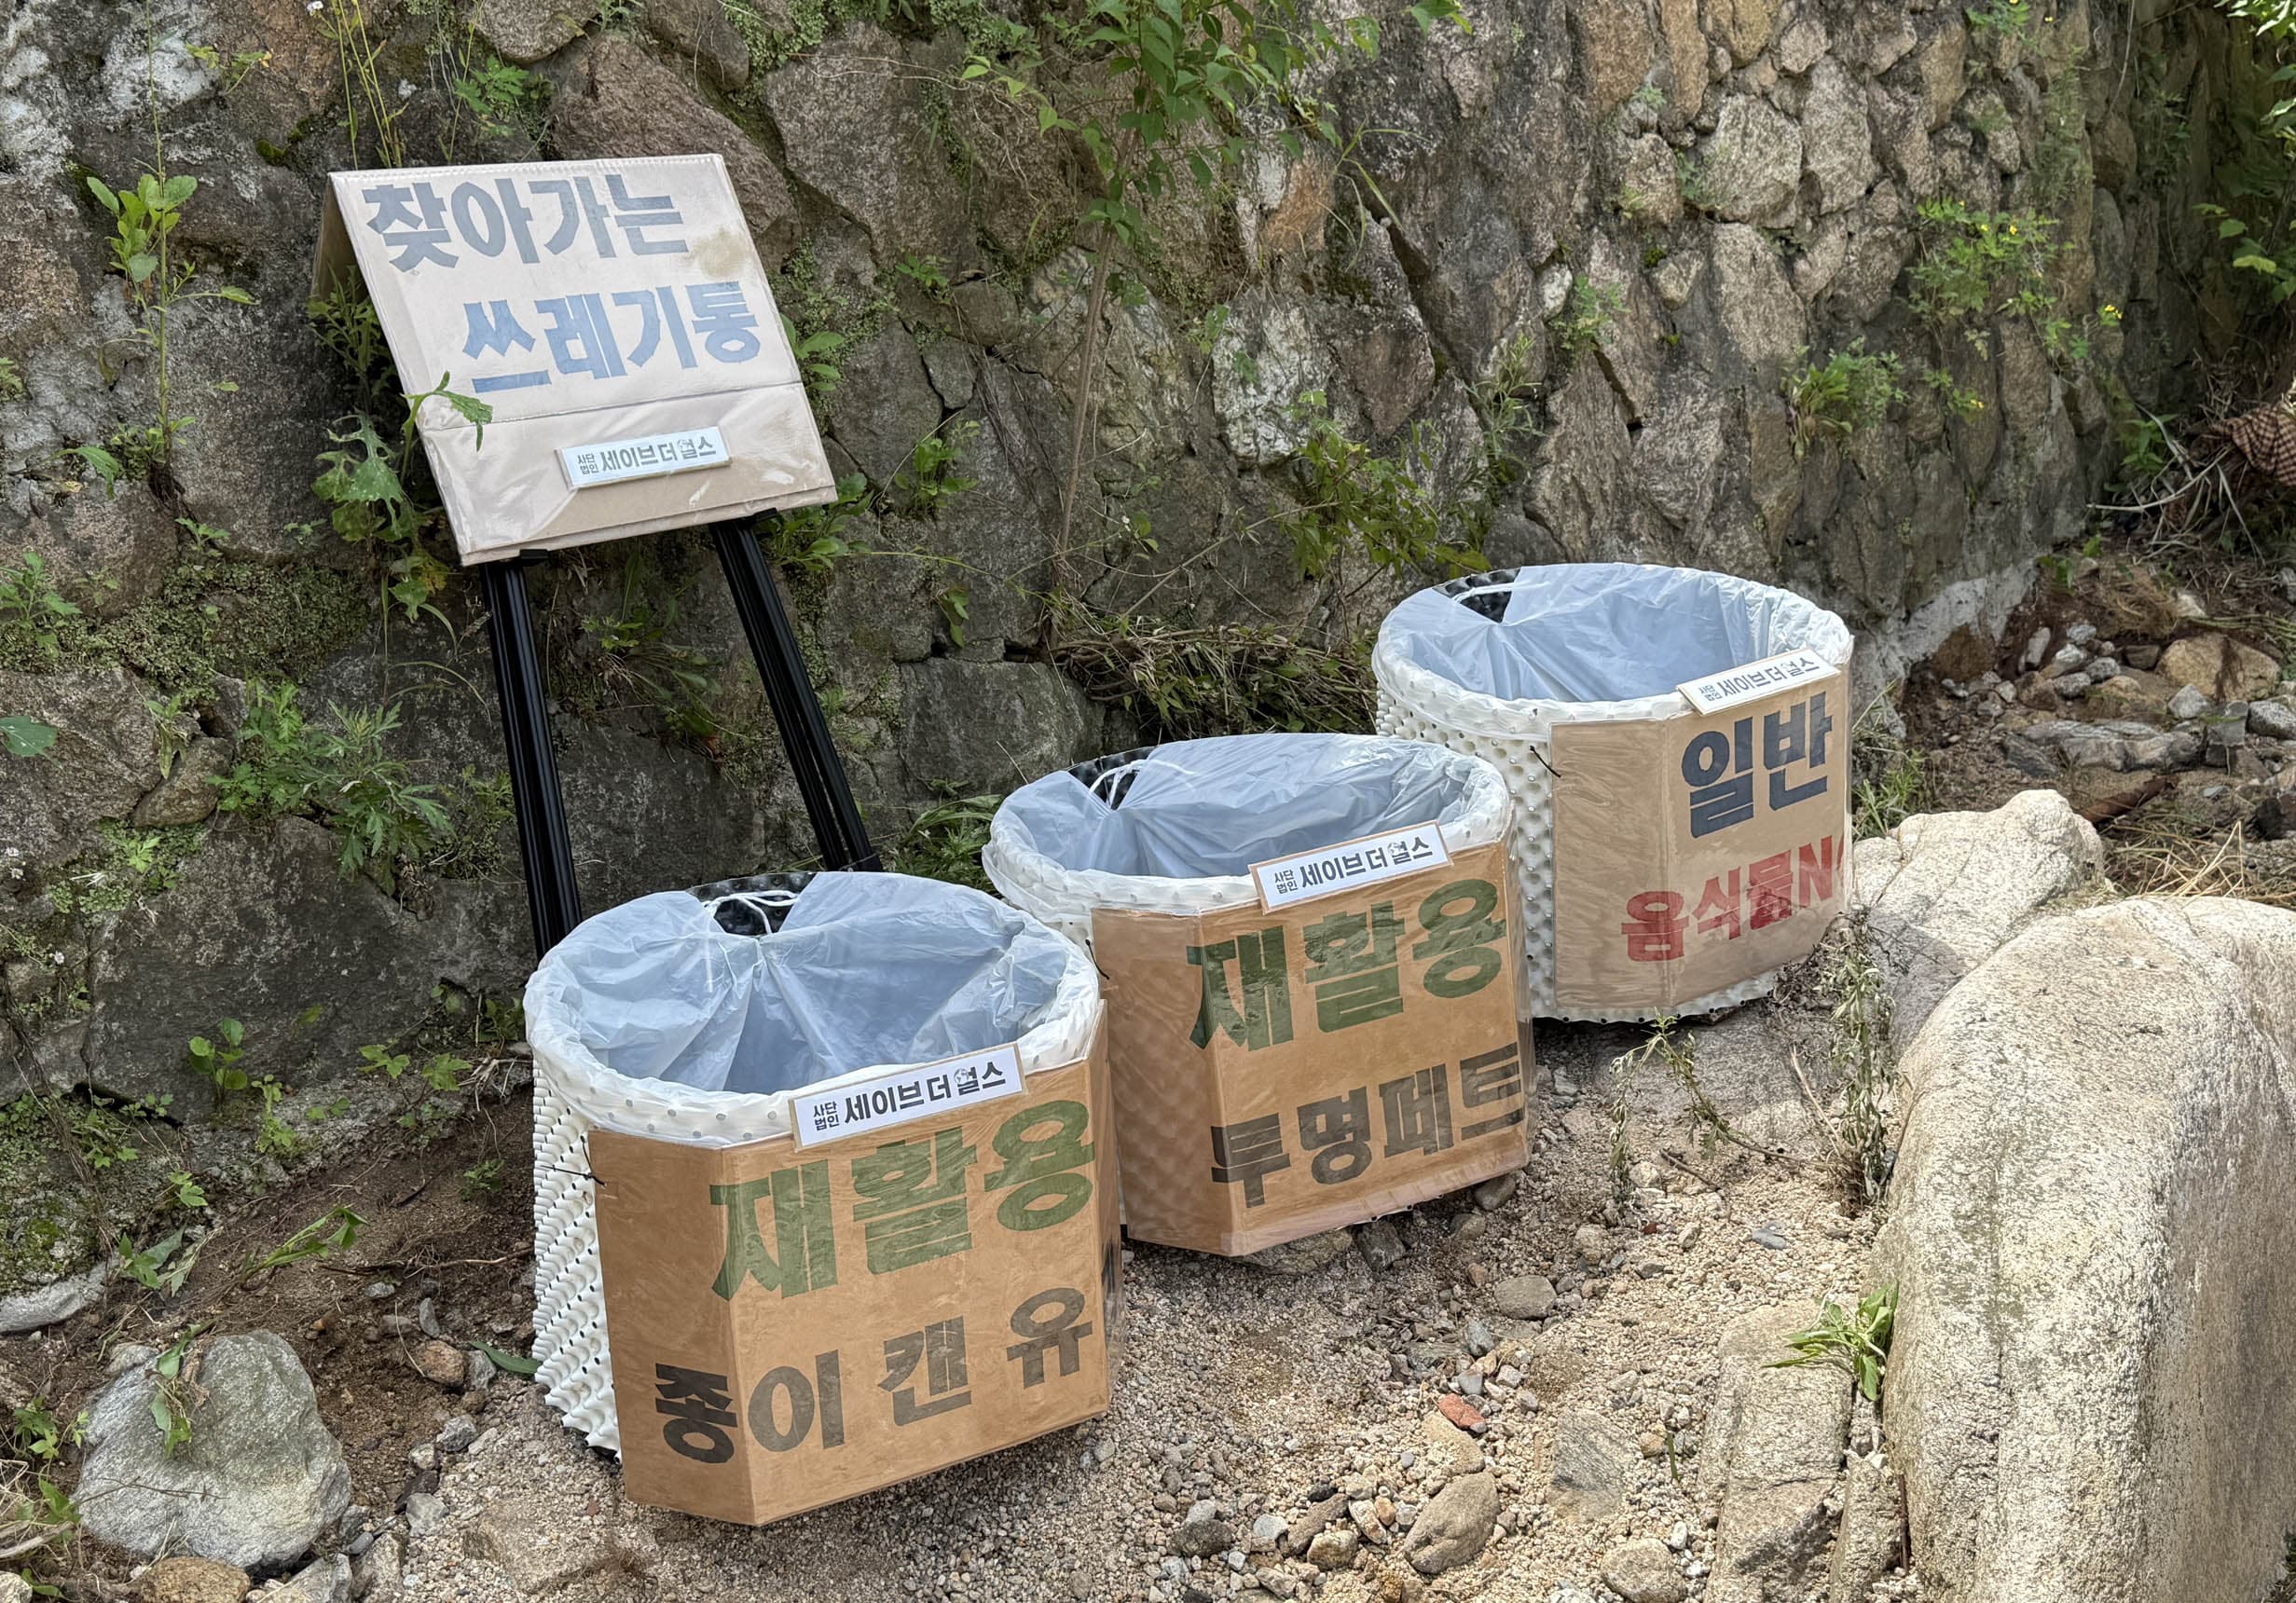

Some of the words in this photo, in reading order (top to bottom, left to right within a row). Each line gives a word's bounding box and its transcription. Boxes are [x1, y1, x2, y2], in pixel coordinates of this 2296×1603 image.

[362, 174, 689, 273] 찾아가는
[462, 281, 761, 393] 쓰레기통
[1681, 692, 1832, 838] 일반
[1274, 870, 1294, 884] 사단
[1276, 881, 1299, 895] 법인
[1186, 879, 1506, 1051] 재활용
[812, 1101, 837, 1118] 사단
[814, 1116, 840, 1131] 법인
[709, 1099, 1096, 1301] 재활용
[655, 1349, 845, 1464] 종이
[877, 1315, 972, 1427] 캔
